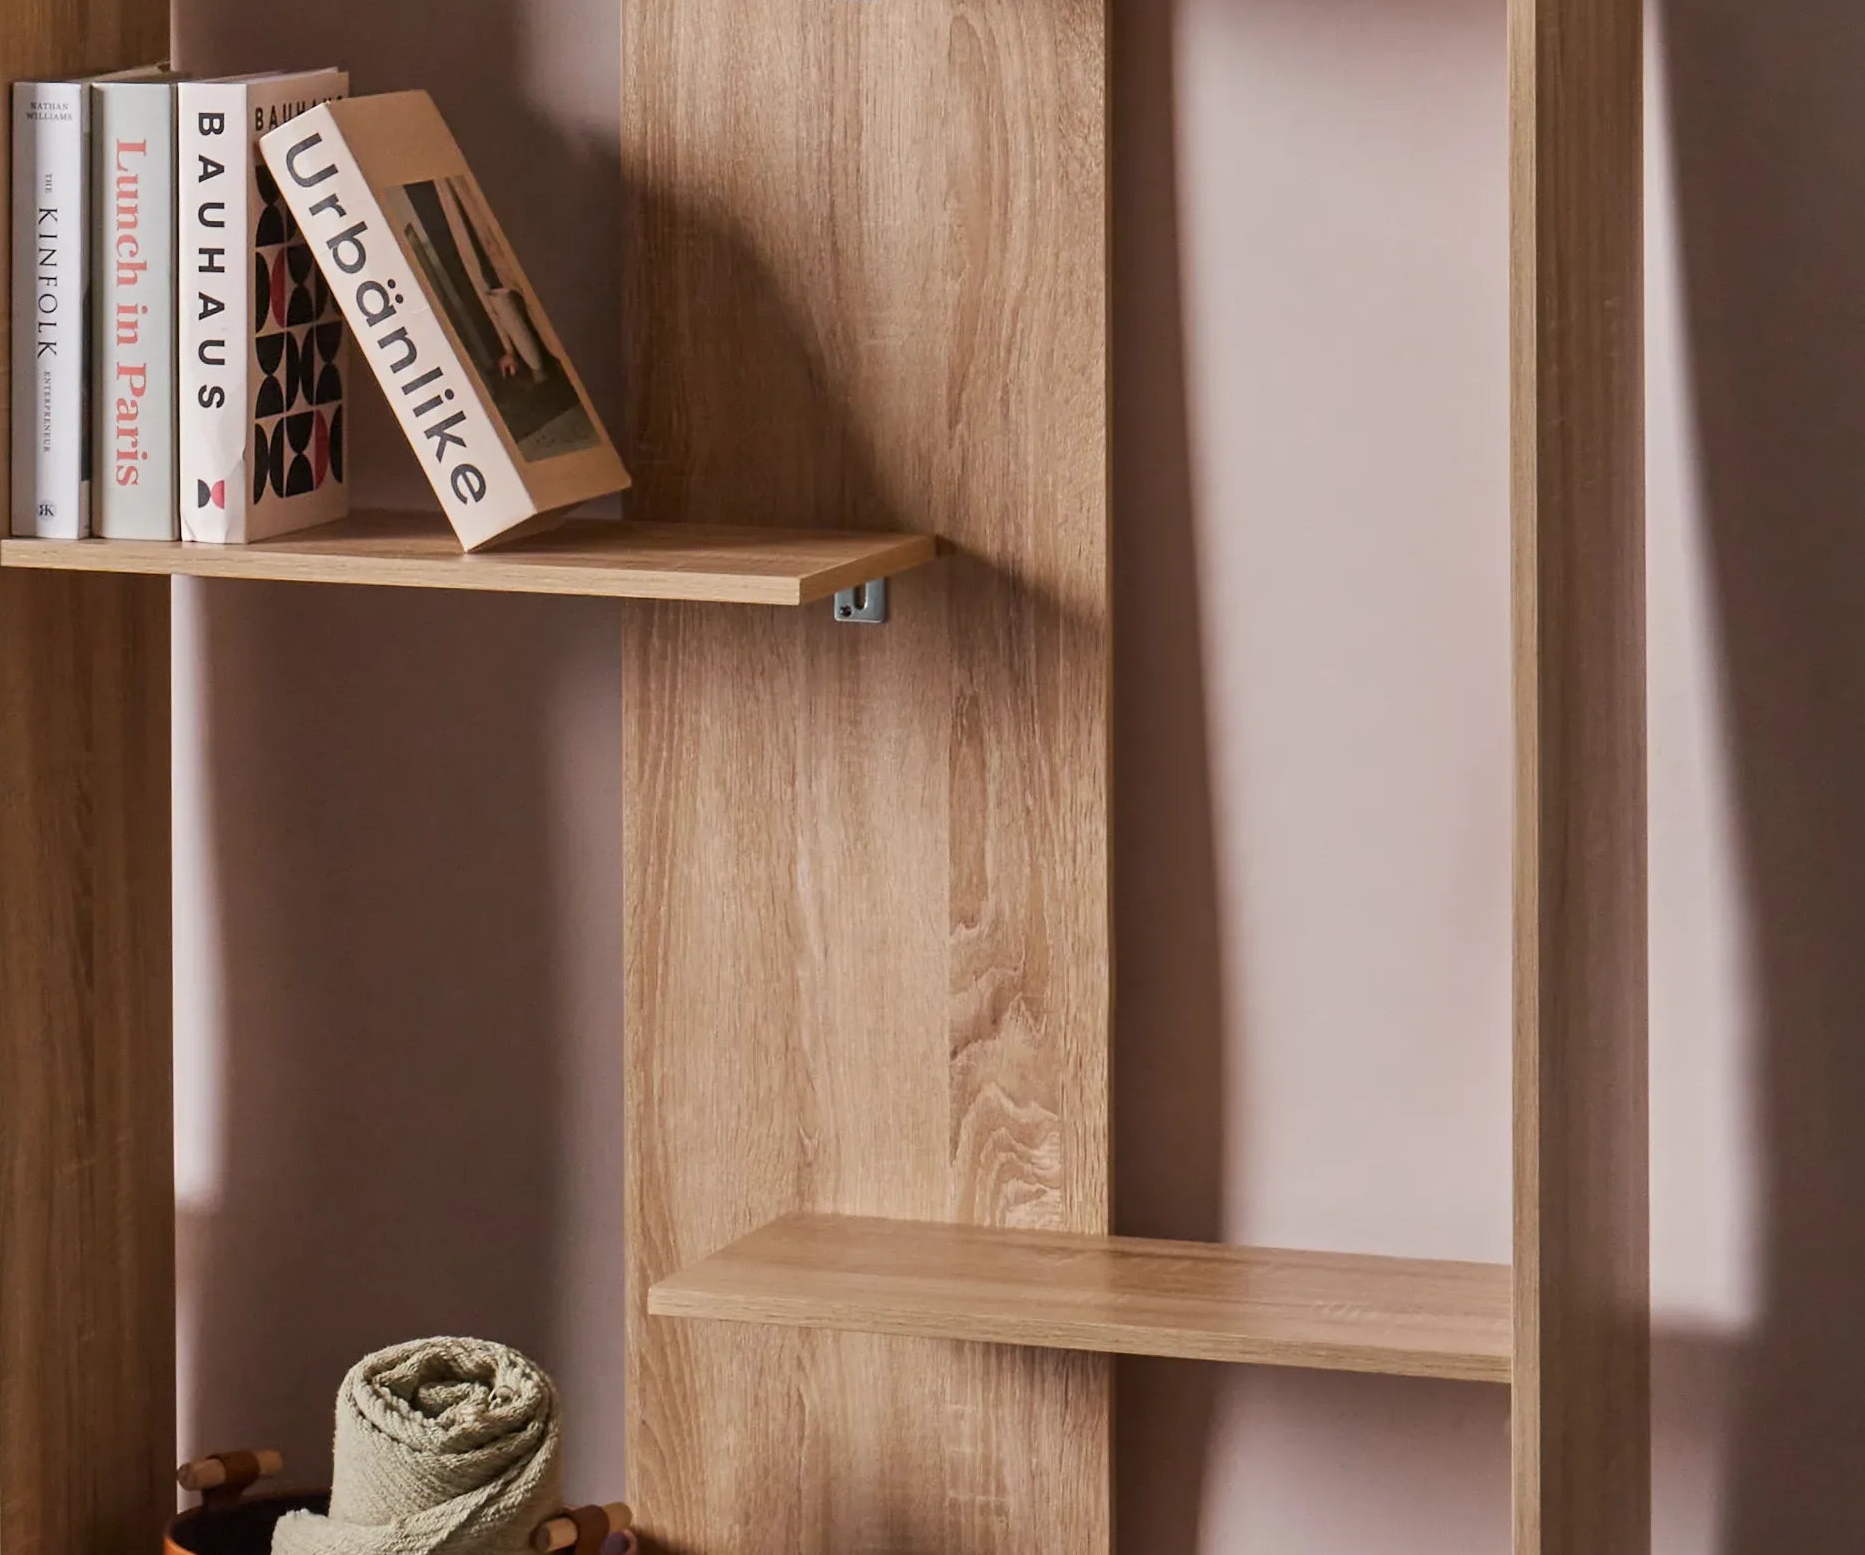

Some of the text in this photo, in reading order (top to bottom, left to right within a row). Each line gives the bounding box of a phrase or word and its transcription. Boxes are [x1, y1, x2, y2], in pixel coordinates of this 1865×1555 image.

[26, 111, 73, 121] WILLIAMS
[30, 101, 69, 110] NATHAN
[255, 95, 344, 131] BAUH
[44, 173, 53, 194] THE
[37, 207, 58, 359] KINFOLK
[197, 112, 226, 409] BAUHAUS
[116, 138, 149, 487] Lunch in Paris
[285, 132, 487, 505] Urbänlike
